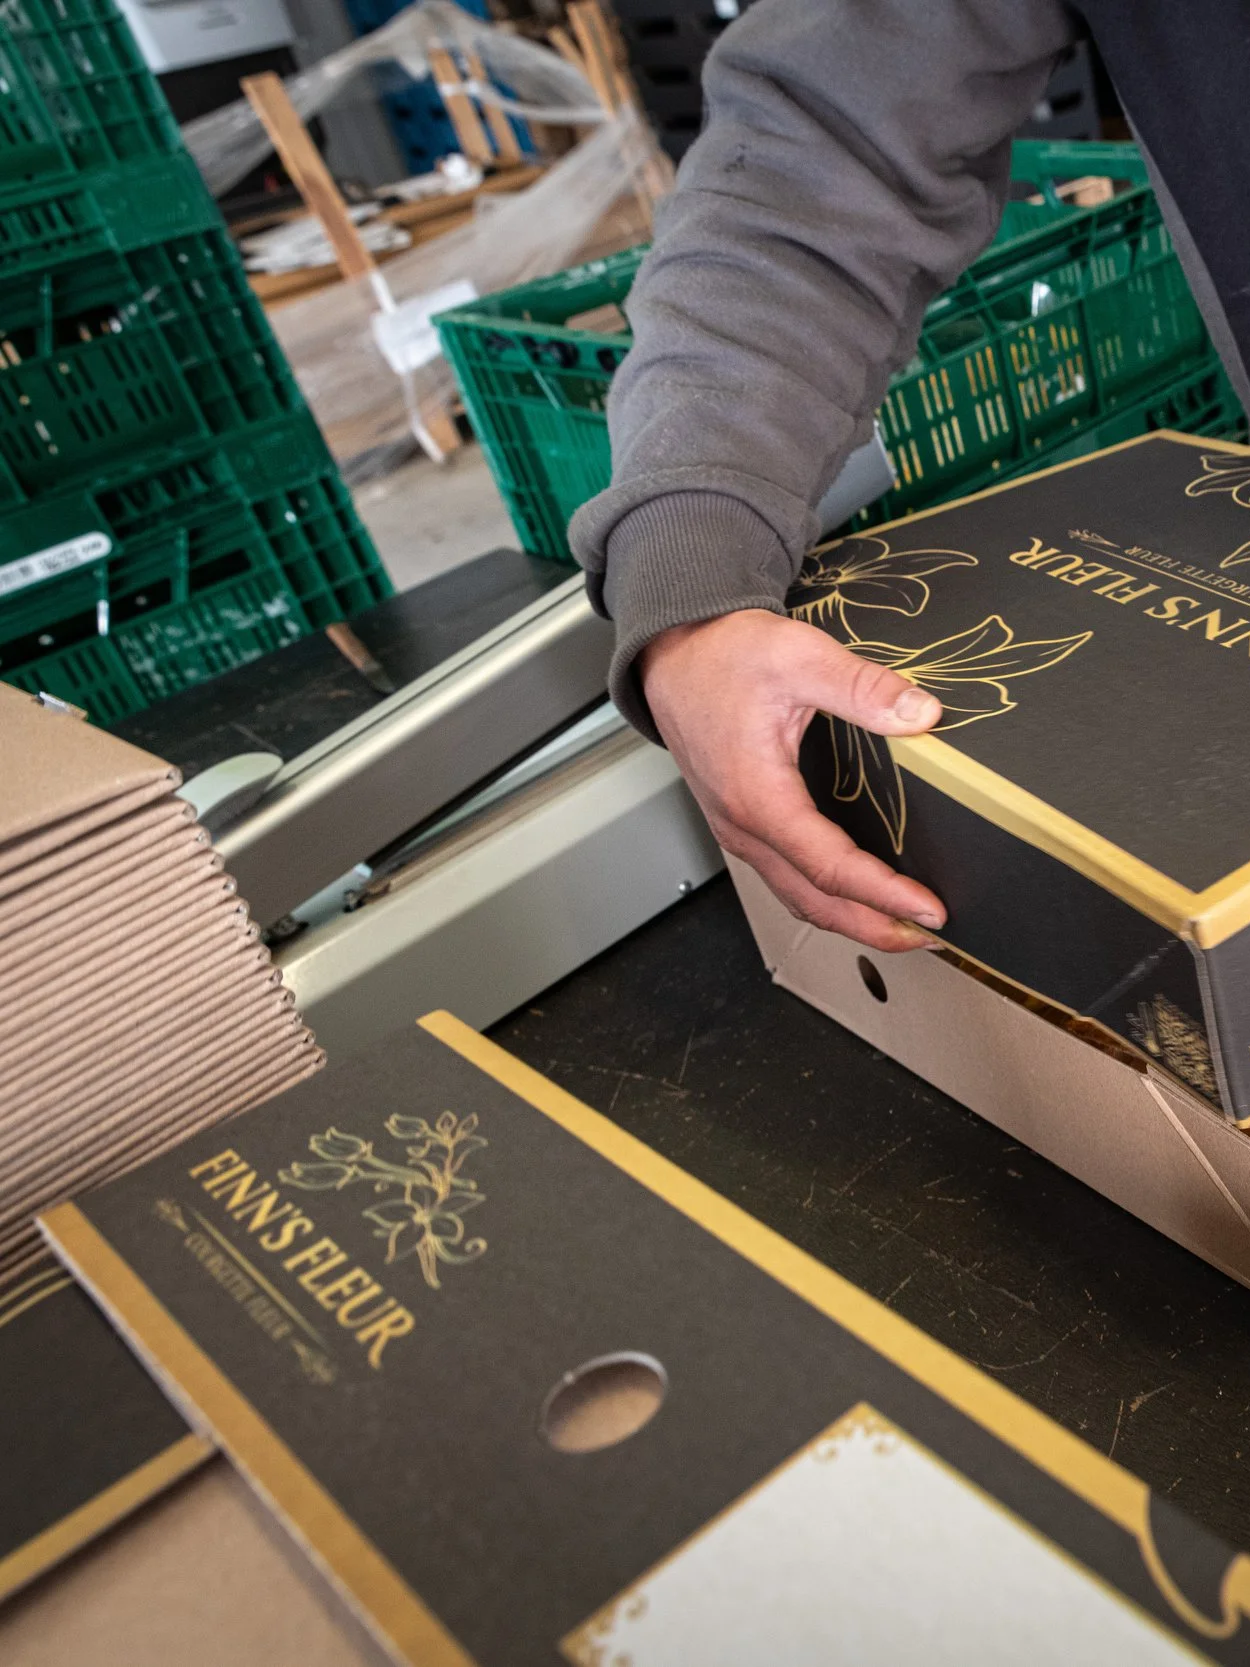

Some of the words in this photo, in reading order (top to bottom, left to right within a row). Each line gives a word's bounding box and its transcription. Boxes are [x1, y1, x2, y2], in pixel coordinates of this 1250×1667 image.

[1008, 536, 1162, 605] FLEUR
[1124, 546, 1181, 569] FLEUR
[188, 1148, 315, 1252] FINN'S
[282, 1236, 416, 1370] FLEUR
